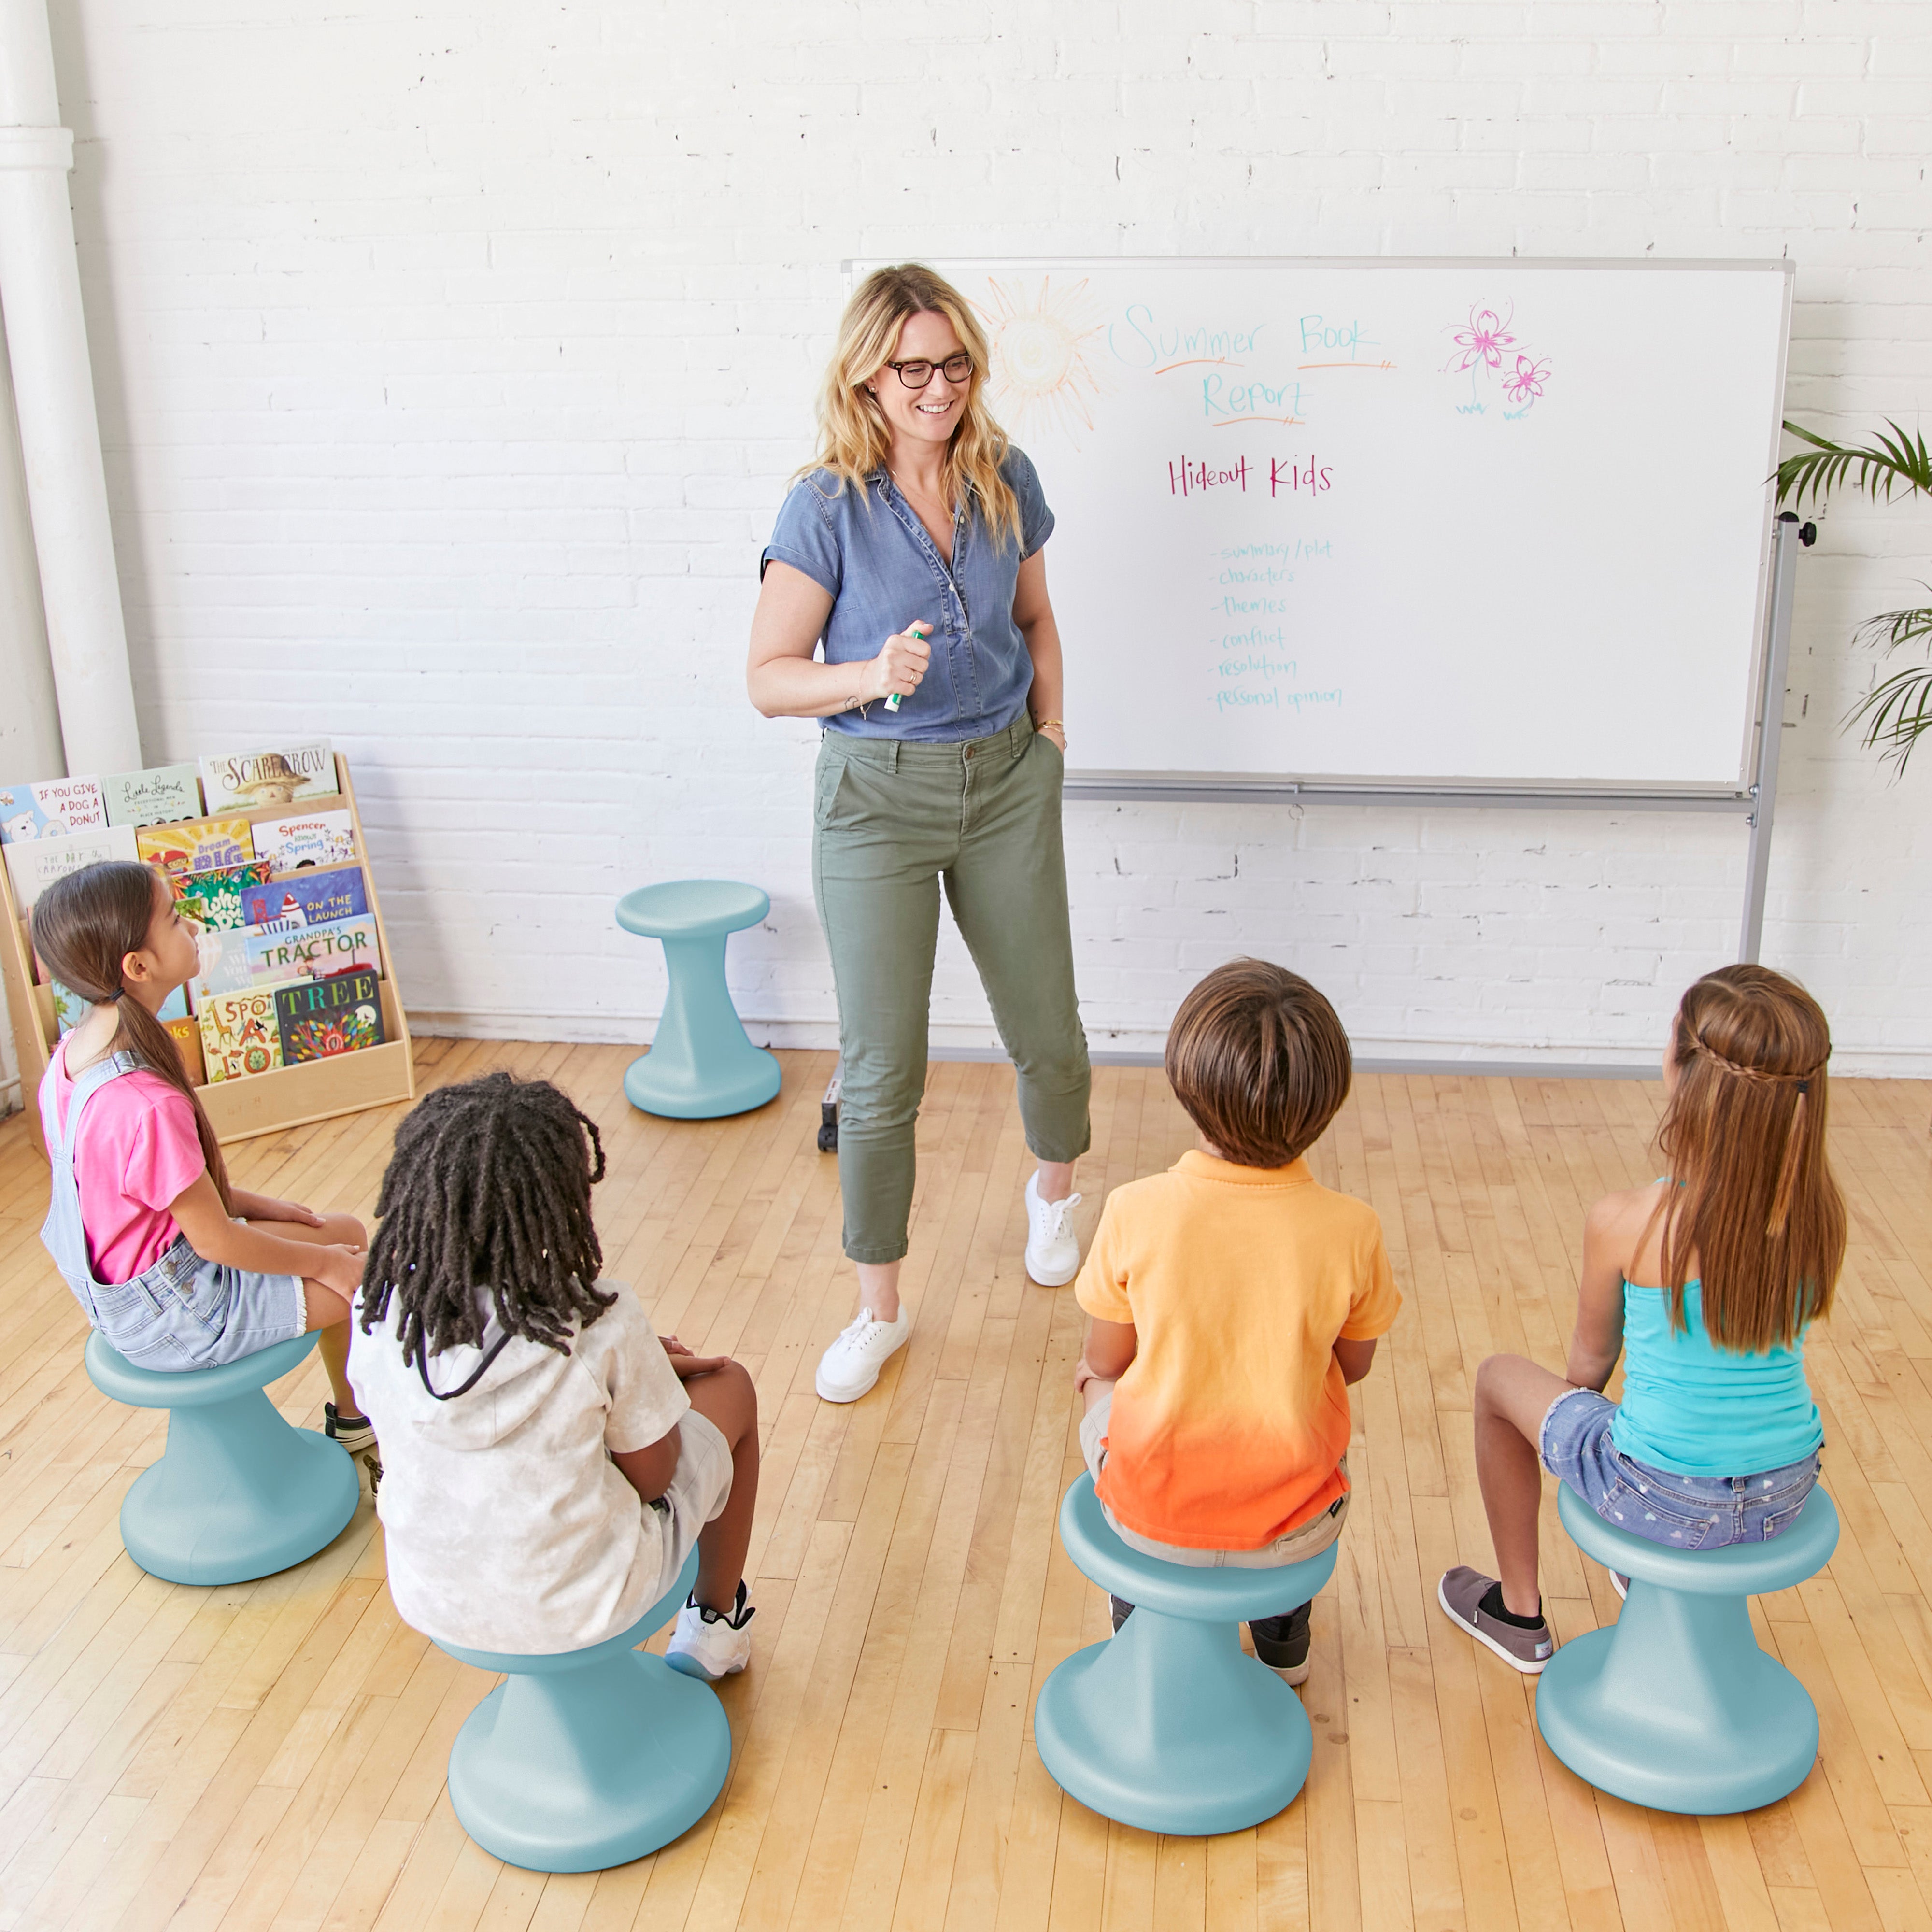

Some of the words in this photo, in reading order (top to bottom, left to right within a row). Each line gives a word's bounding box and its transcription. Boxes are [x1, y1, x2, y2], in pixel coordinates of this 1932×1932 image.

[1108, 304, 1266, 368] Summer
[1300, 314, 1381, 361] Book
[1202, 373, 1314, 417] Report
[1168, 454, 1254, 497] Hideout
[1270, 455, 1334, 498] Kids
[1287, 688, 1342, 714] opinion
[210, 760, 228, 774] THE
[222, 748, 326, 791] SCARECROW
[39, 789, 48, 801] IF
[52, 787, 71, 798] YOU
[73, 783, 98, 795] GIVE
[121, 781, 150, 803] Little
[151, 775, 185, 796] Legends
[60, 803, 66, 813] A
[69, 799, 89, 811] DOG
[93, 797, 99, 808] A
[70, 811, 100, 826] DONUT
[279, 822, 326, 837] Spencer
[66, 852, 84, 863] DAY
[193, 845, 244, 870] BIG
[198, 839, 230, 854] Dream
[285, 839, 324, 855] Spring
[307, 901, 324, 911] ON
[328, 894, 352, 907] THE
[309, 907, 353, 923] LAUNCH
[285, 926, 341, 945] GRANDPA'S
[261, 931, 368, 967] TRACTOR
[282, 976, 374, 1016] TREE
[226, 1000, 267, 1022] SPO
[239, 1018, 266, 1047] A
[222, 1046, 271, 1080] LO
